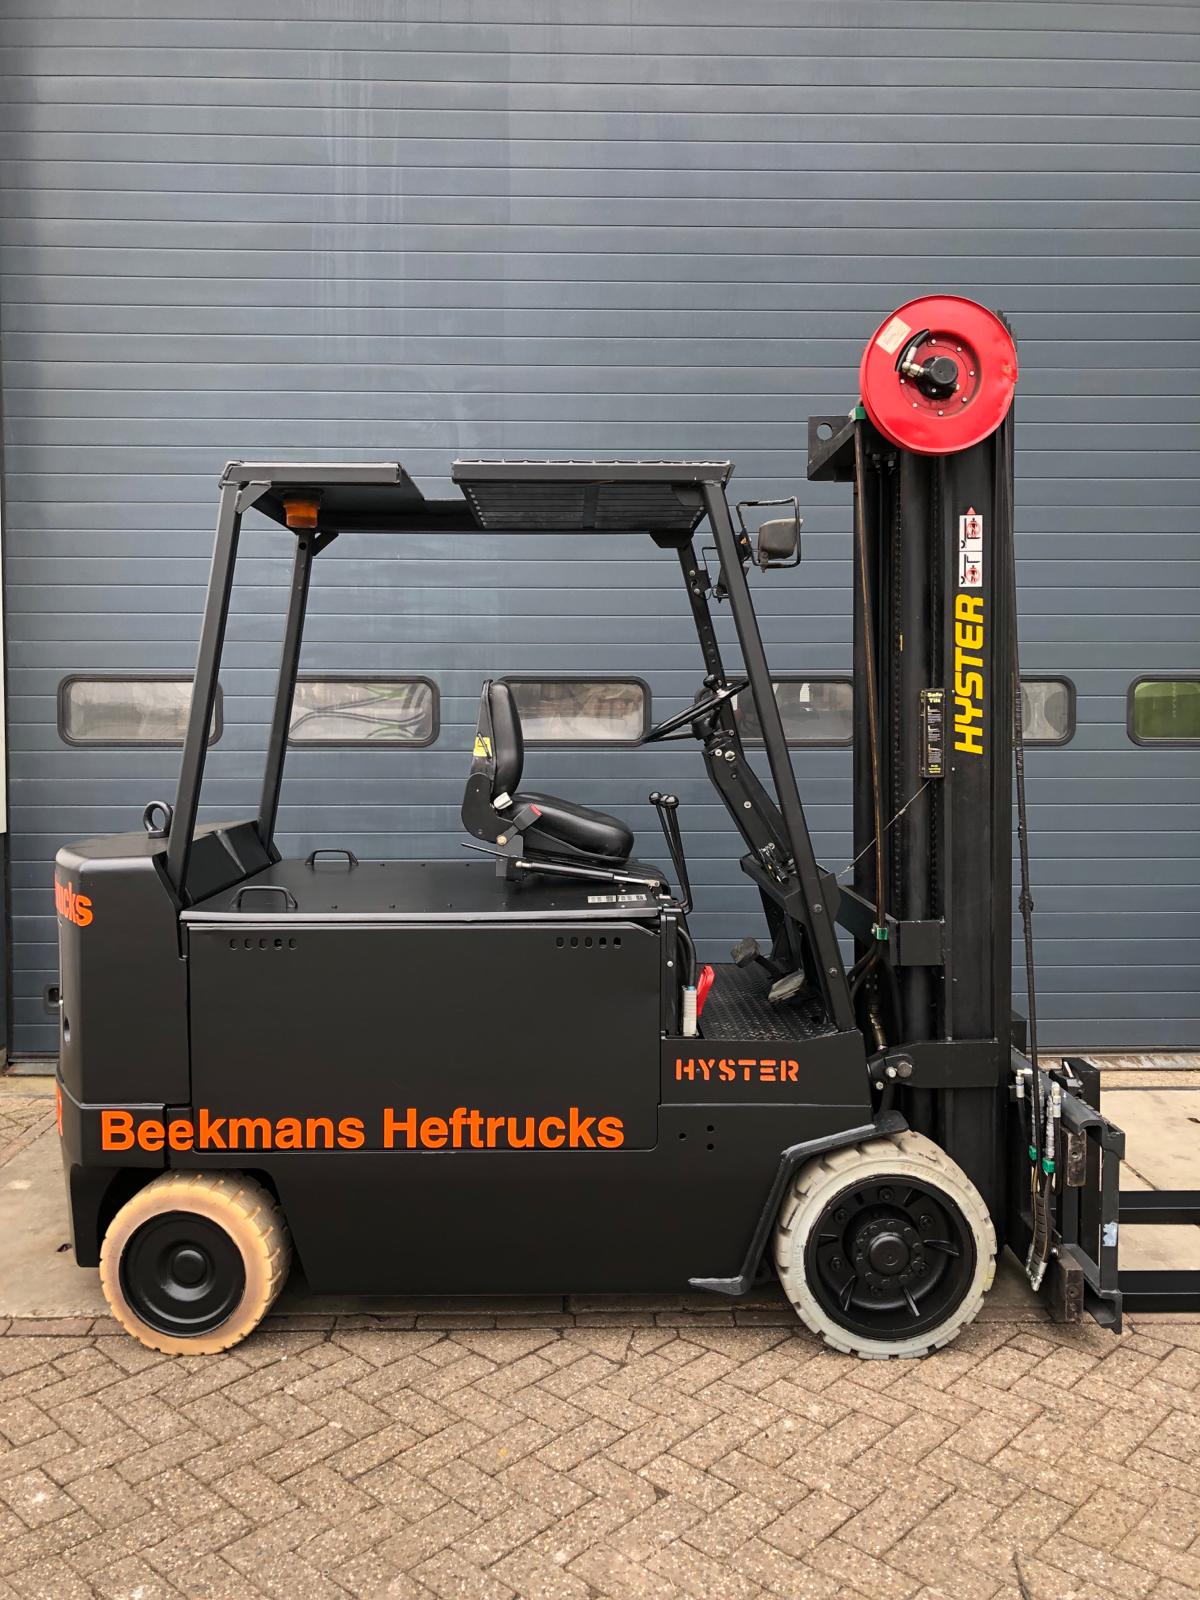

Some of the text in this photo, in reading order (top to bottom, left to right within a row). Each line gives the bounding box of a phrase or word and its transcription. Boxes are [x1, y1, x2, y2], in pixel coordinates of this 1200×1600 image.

[954, 594, 984, 754] HYSTER
[55, 880, 93, 927] ucks
[675, 1059, 799, 1081] HYSTER
[101, 1109, 365, 1151] Beekmans
[384, 1108, 625, 1149] Heftrucks
